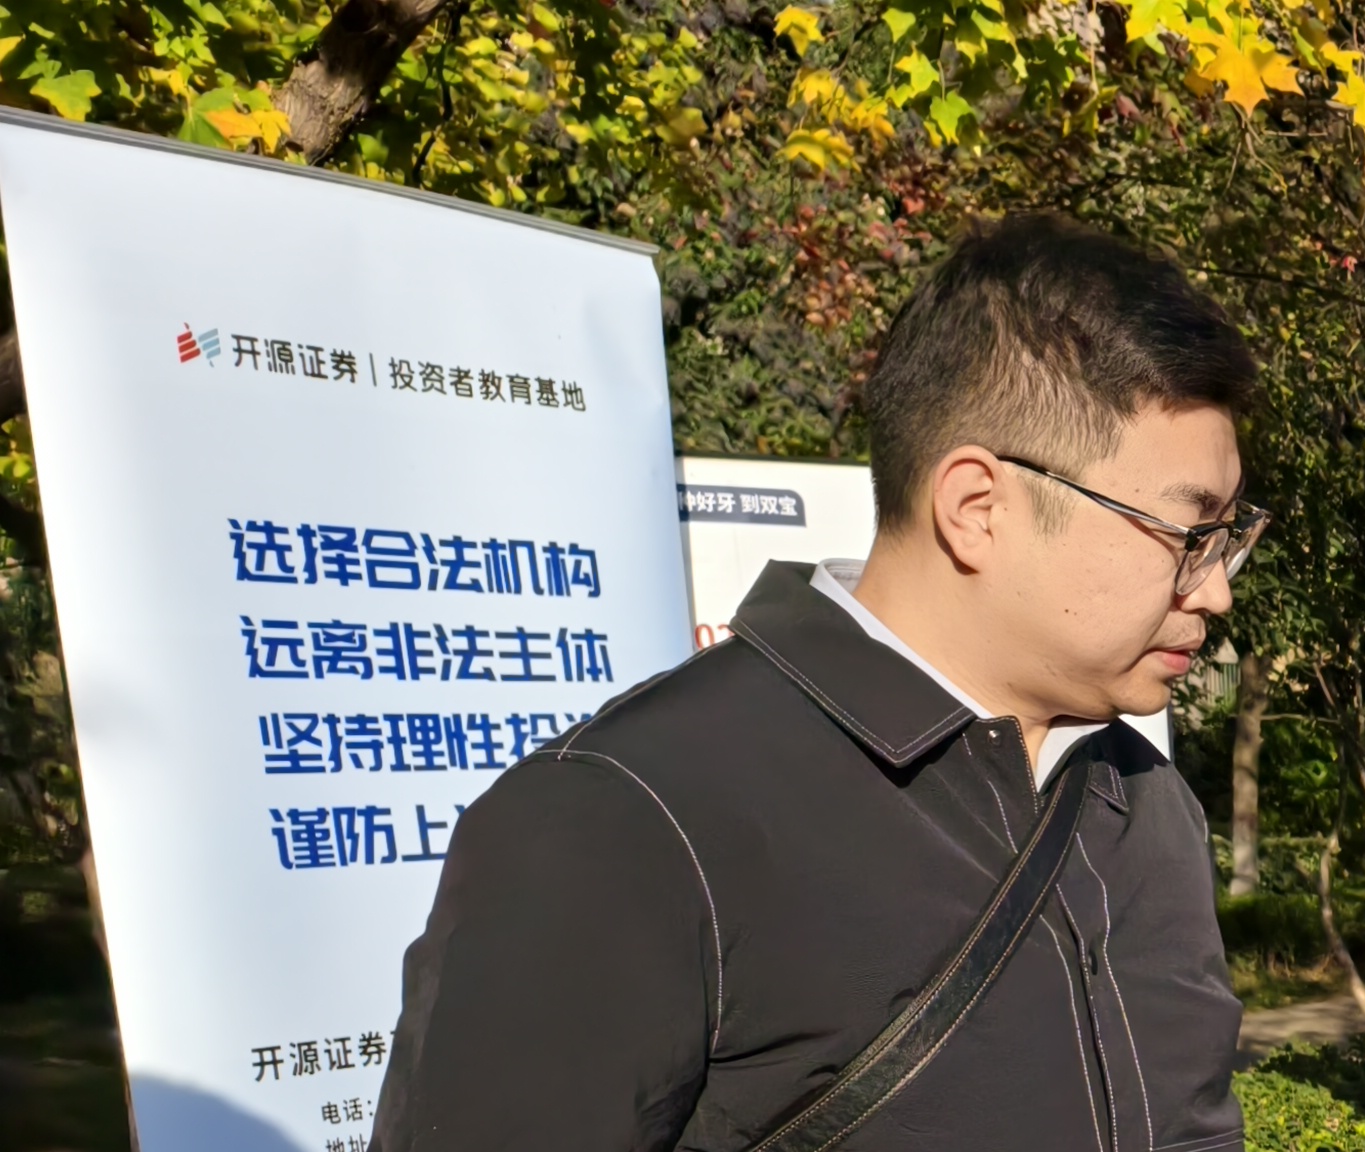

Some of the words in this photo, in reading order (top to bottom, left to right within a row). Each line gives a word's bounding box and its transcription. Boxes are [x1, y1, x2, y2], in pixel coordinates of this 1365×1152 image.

[231, 334, 359, 384] 开源证券
[388, 357, 588, 413] 投资者教育基地
[740, 493, 798, 517] 到双宝
[226, 518, 602, 599] 选择合法机构
[239, 614, 615, 683] 远离非法主体
[258, 712, 592, 776] 坚持理性投
[268, 803, 466, 870] 谨防上
[251, 1030, 397, 1083] 开源证券
